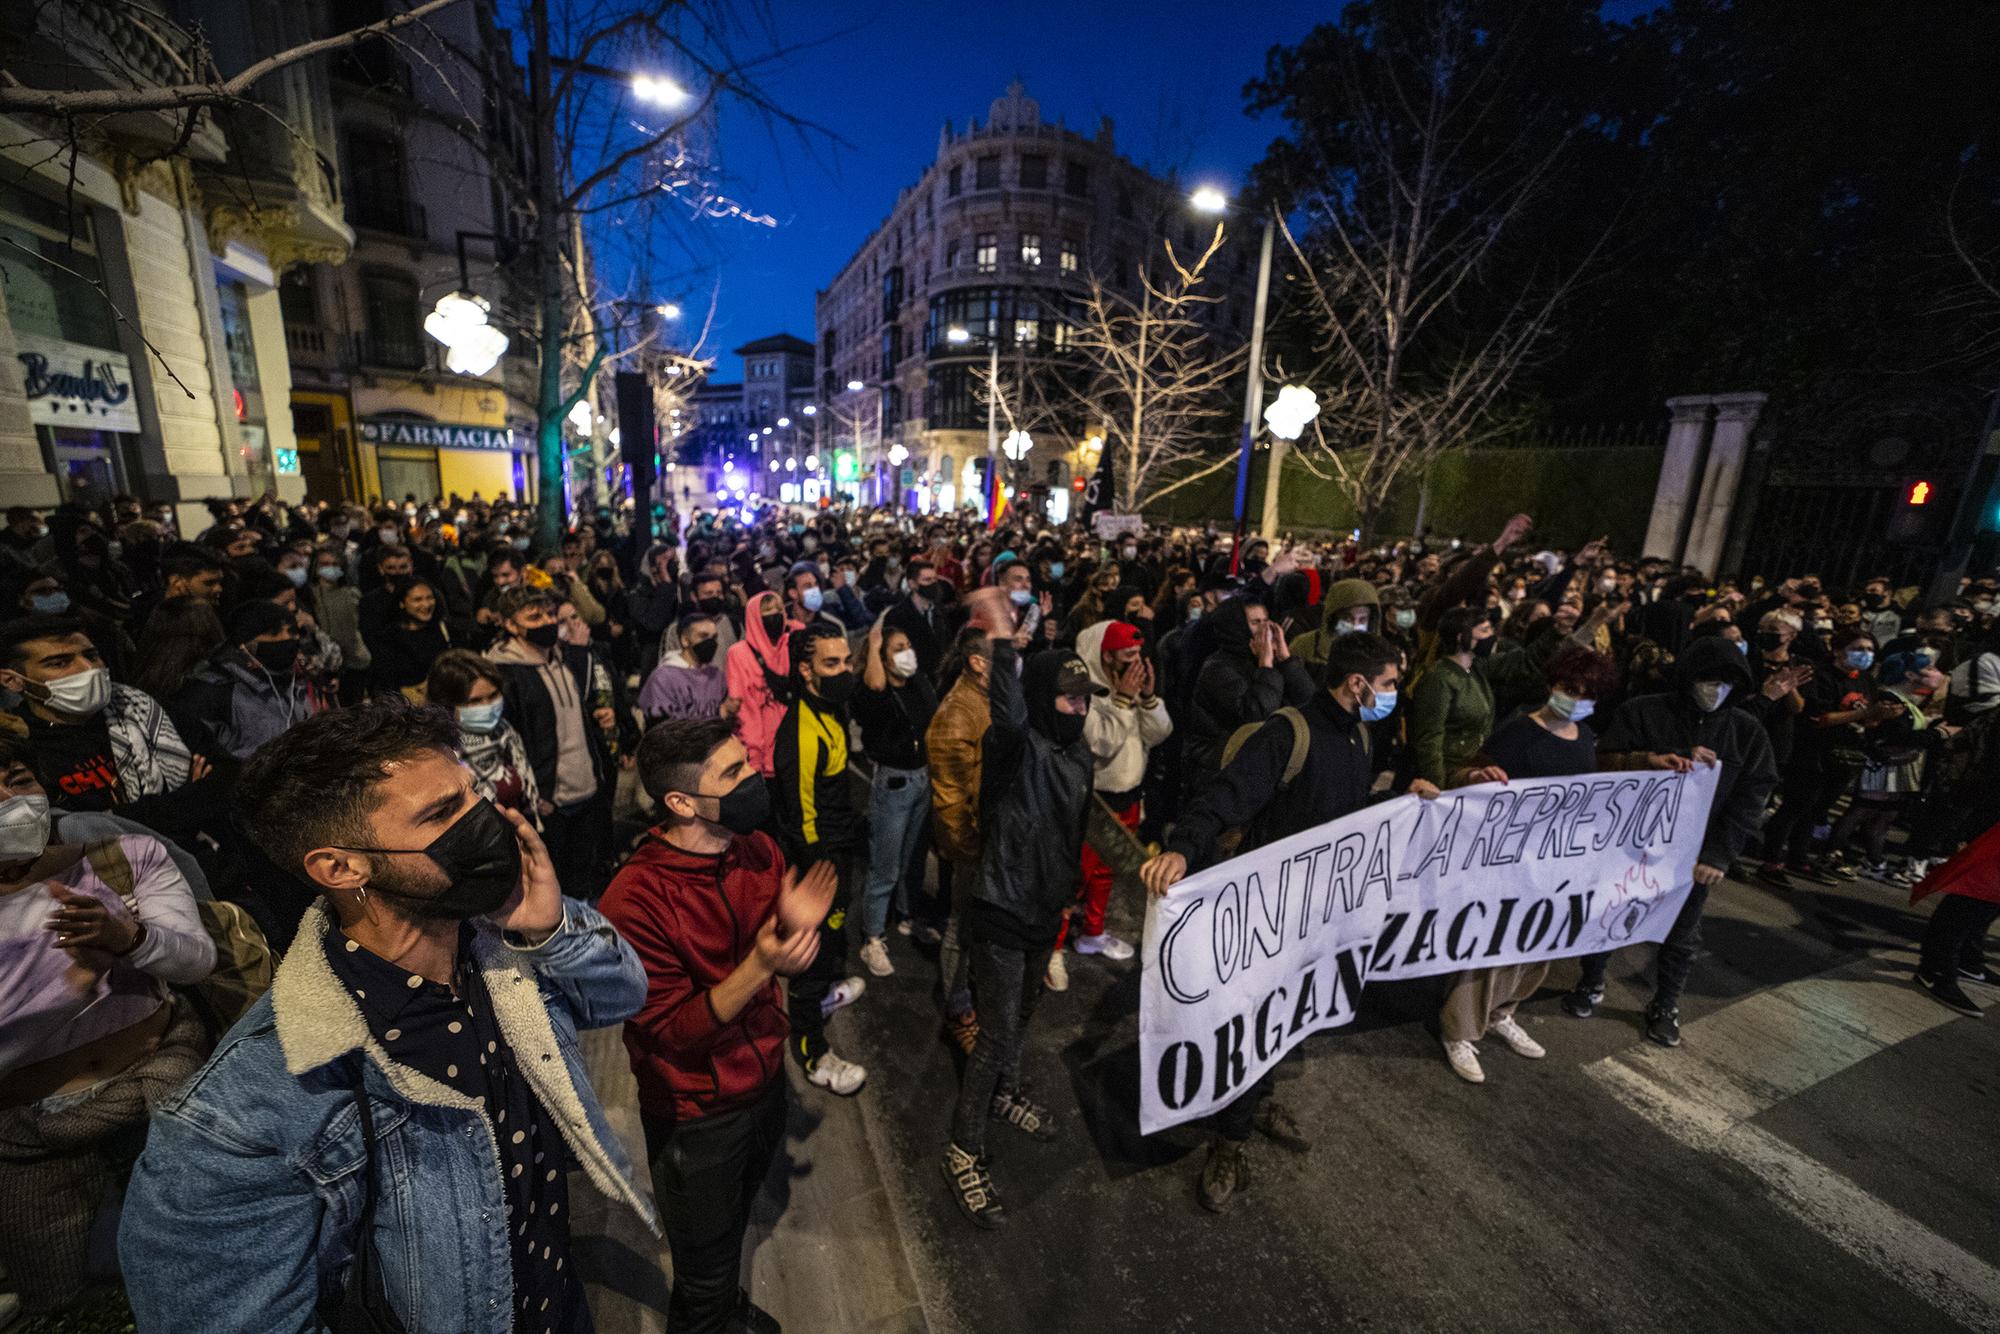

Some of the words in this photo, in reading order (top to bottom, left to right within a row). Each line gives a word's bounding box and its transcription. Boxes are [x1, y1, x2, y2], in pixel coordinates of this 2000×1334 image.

[379, 423, 508, 449] FARMACIA
[1157, 879, 1595, 1111] ORGANZACIÓN
[1159, 819, 1392, 1004] CONTRA
[1397, 795, 1464, 881] LA
